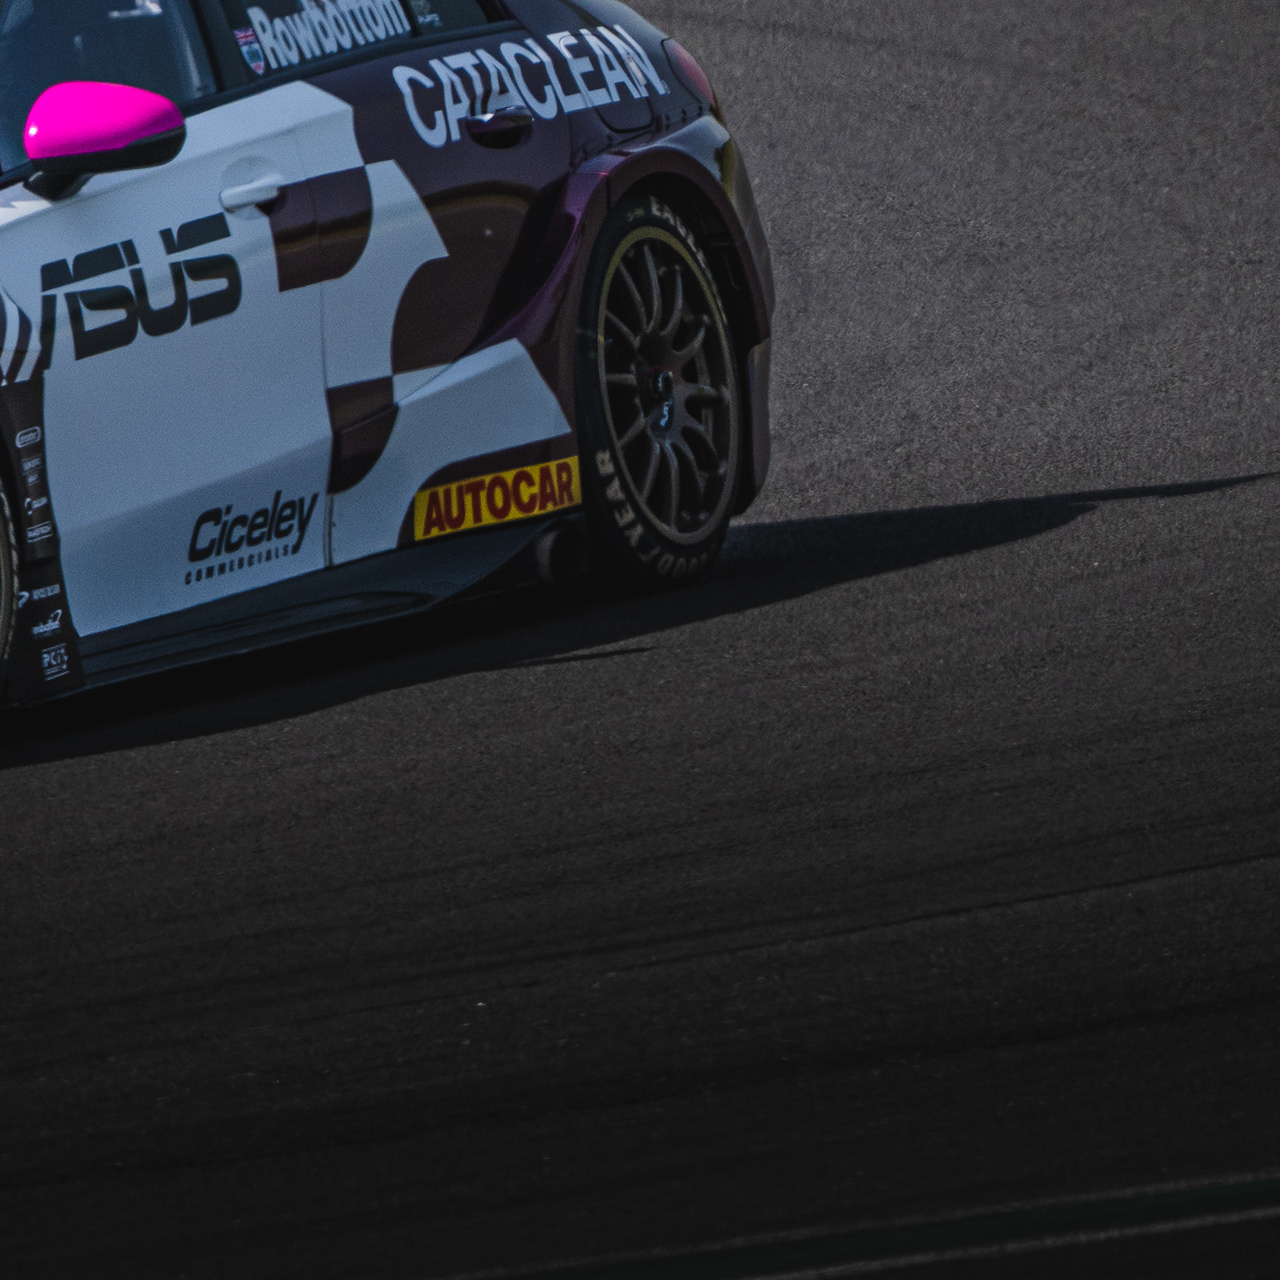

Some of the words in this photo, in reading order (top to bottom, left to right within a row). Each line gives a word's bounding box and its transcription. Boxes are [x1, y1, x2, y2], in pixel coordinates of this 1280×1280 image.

[392, 24, 666, 148] CATACLEAN
[40, 212, 242, 370] ASUS
[188, 489, 319, 563] Ciceley
[423, 461, 574, 536] AUTOCAR
[184, 544, 289, 585] COMMERCIALS
